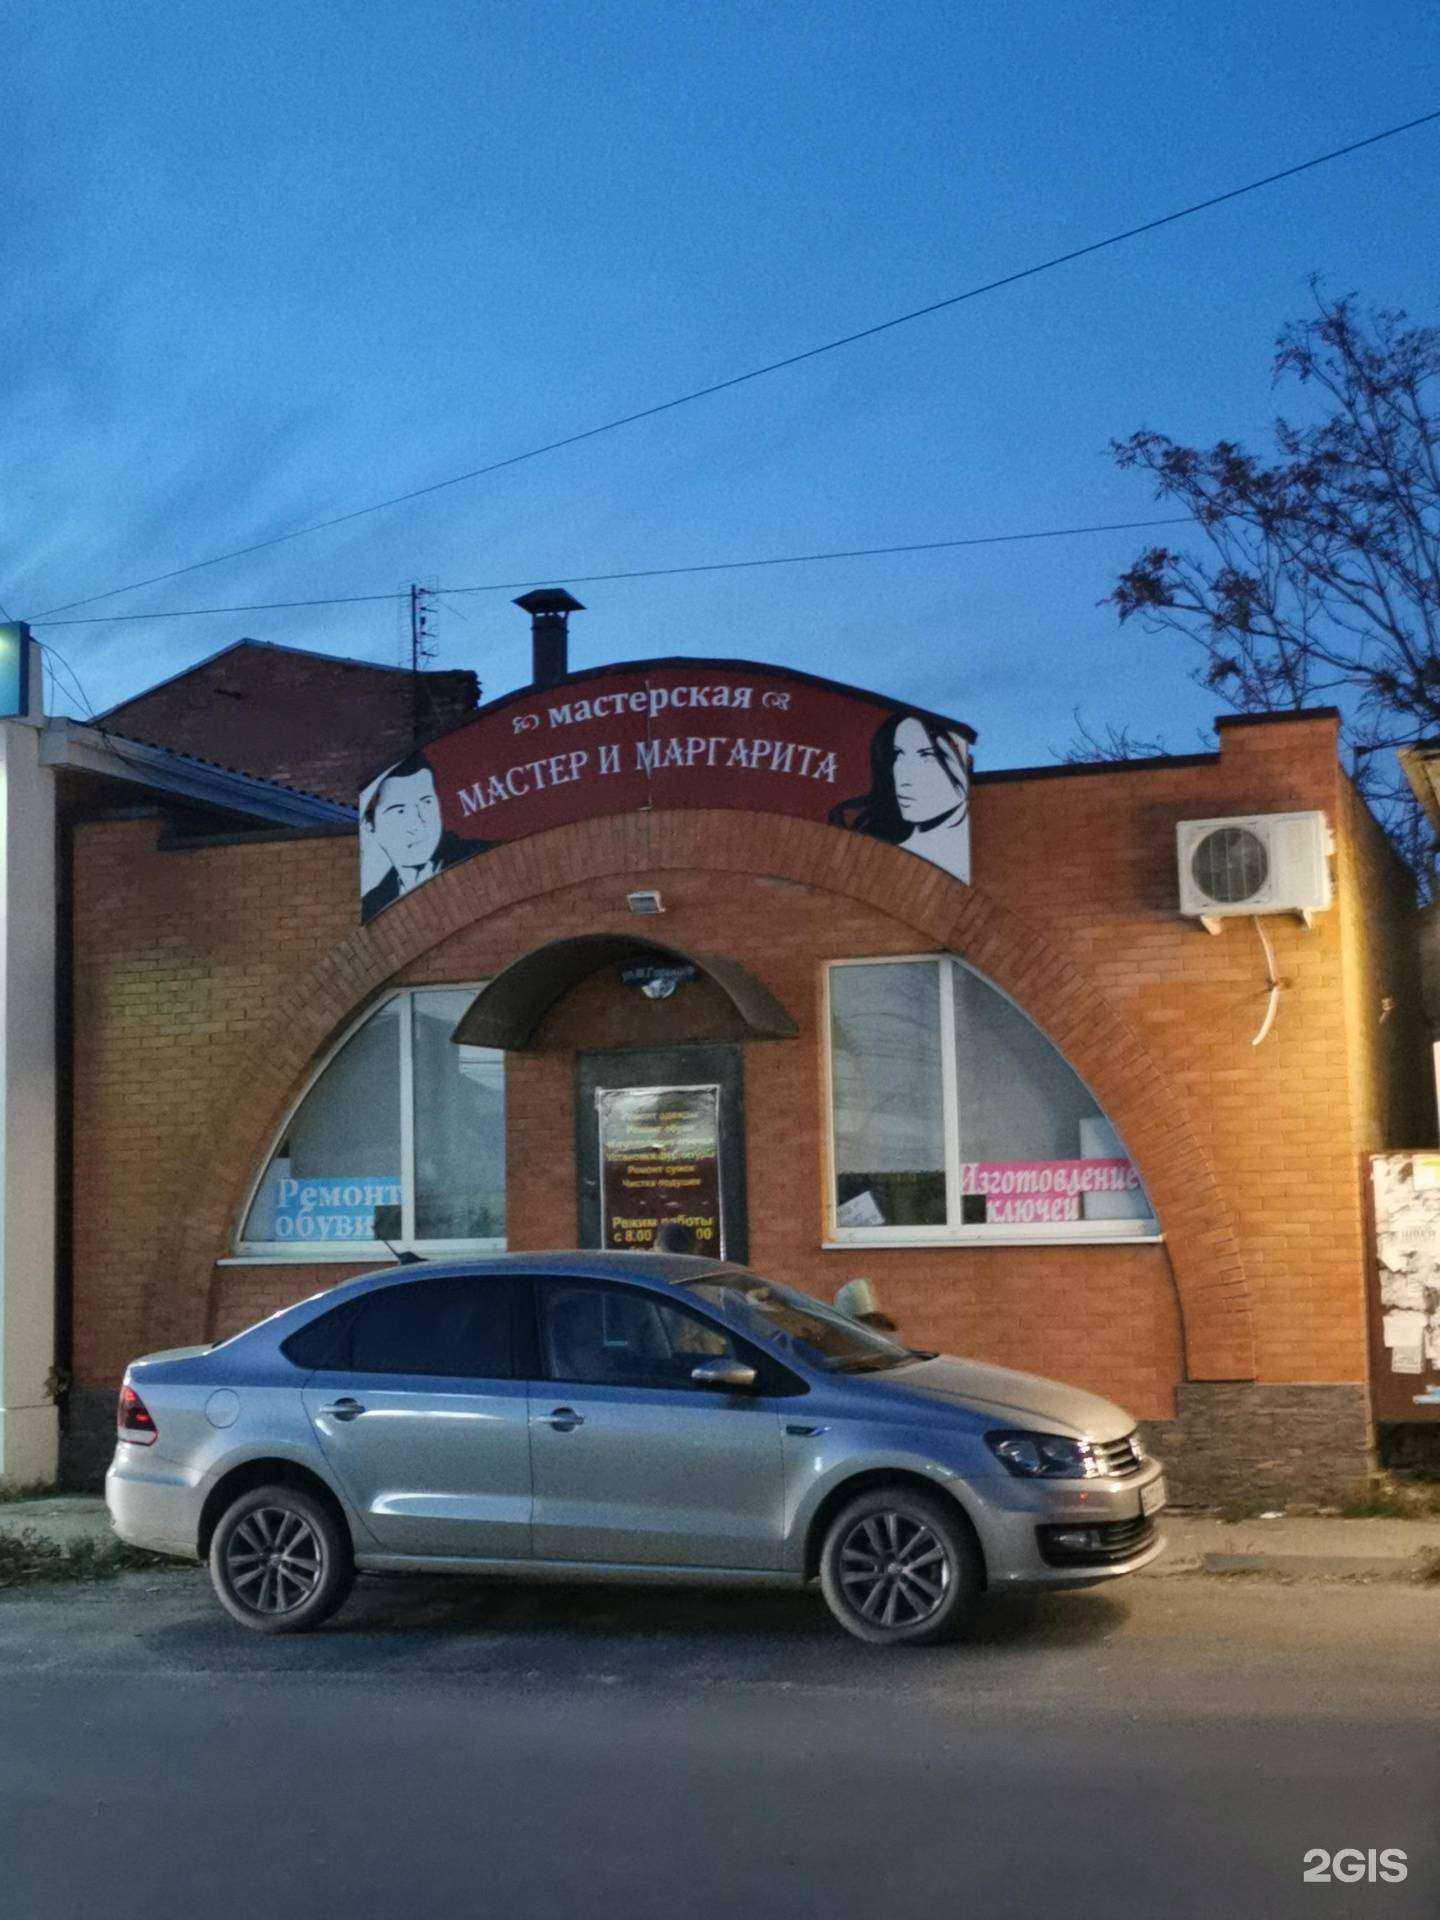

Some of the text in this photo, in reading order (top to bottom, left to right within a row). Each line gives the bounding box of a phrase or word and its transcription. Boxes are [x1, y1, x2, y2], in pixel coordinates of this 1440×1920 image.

[547, 685, 754, 729] мастерская
[456, 737, 838, 817] МАСТЕР И МАРГАРИТА
[277, 1178, 402, 1208] Ремонт
[274, 1204, 375, 1240] обуви
